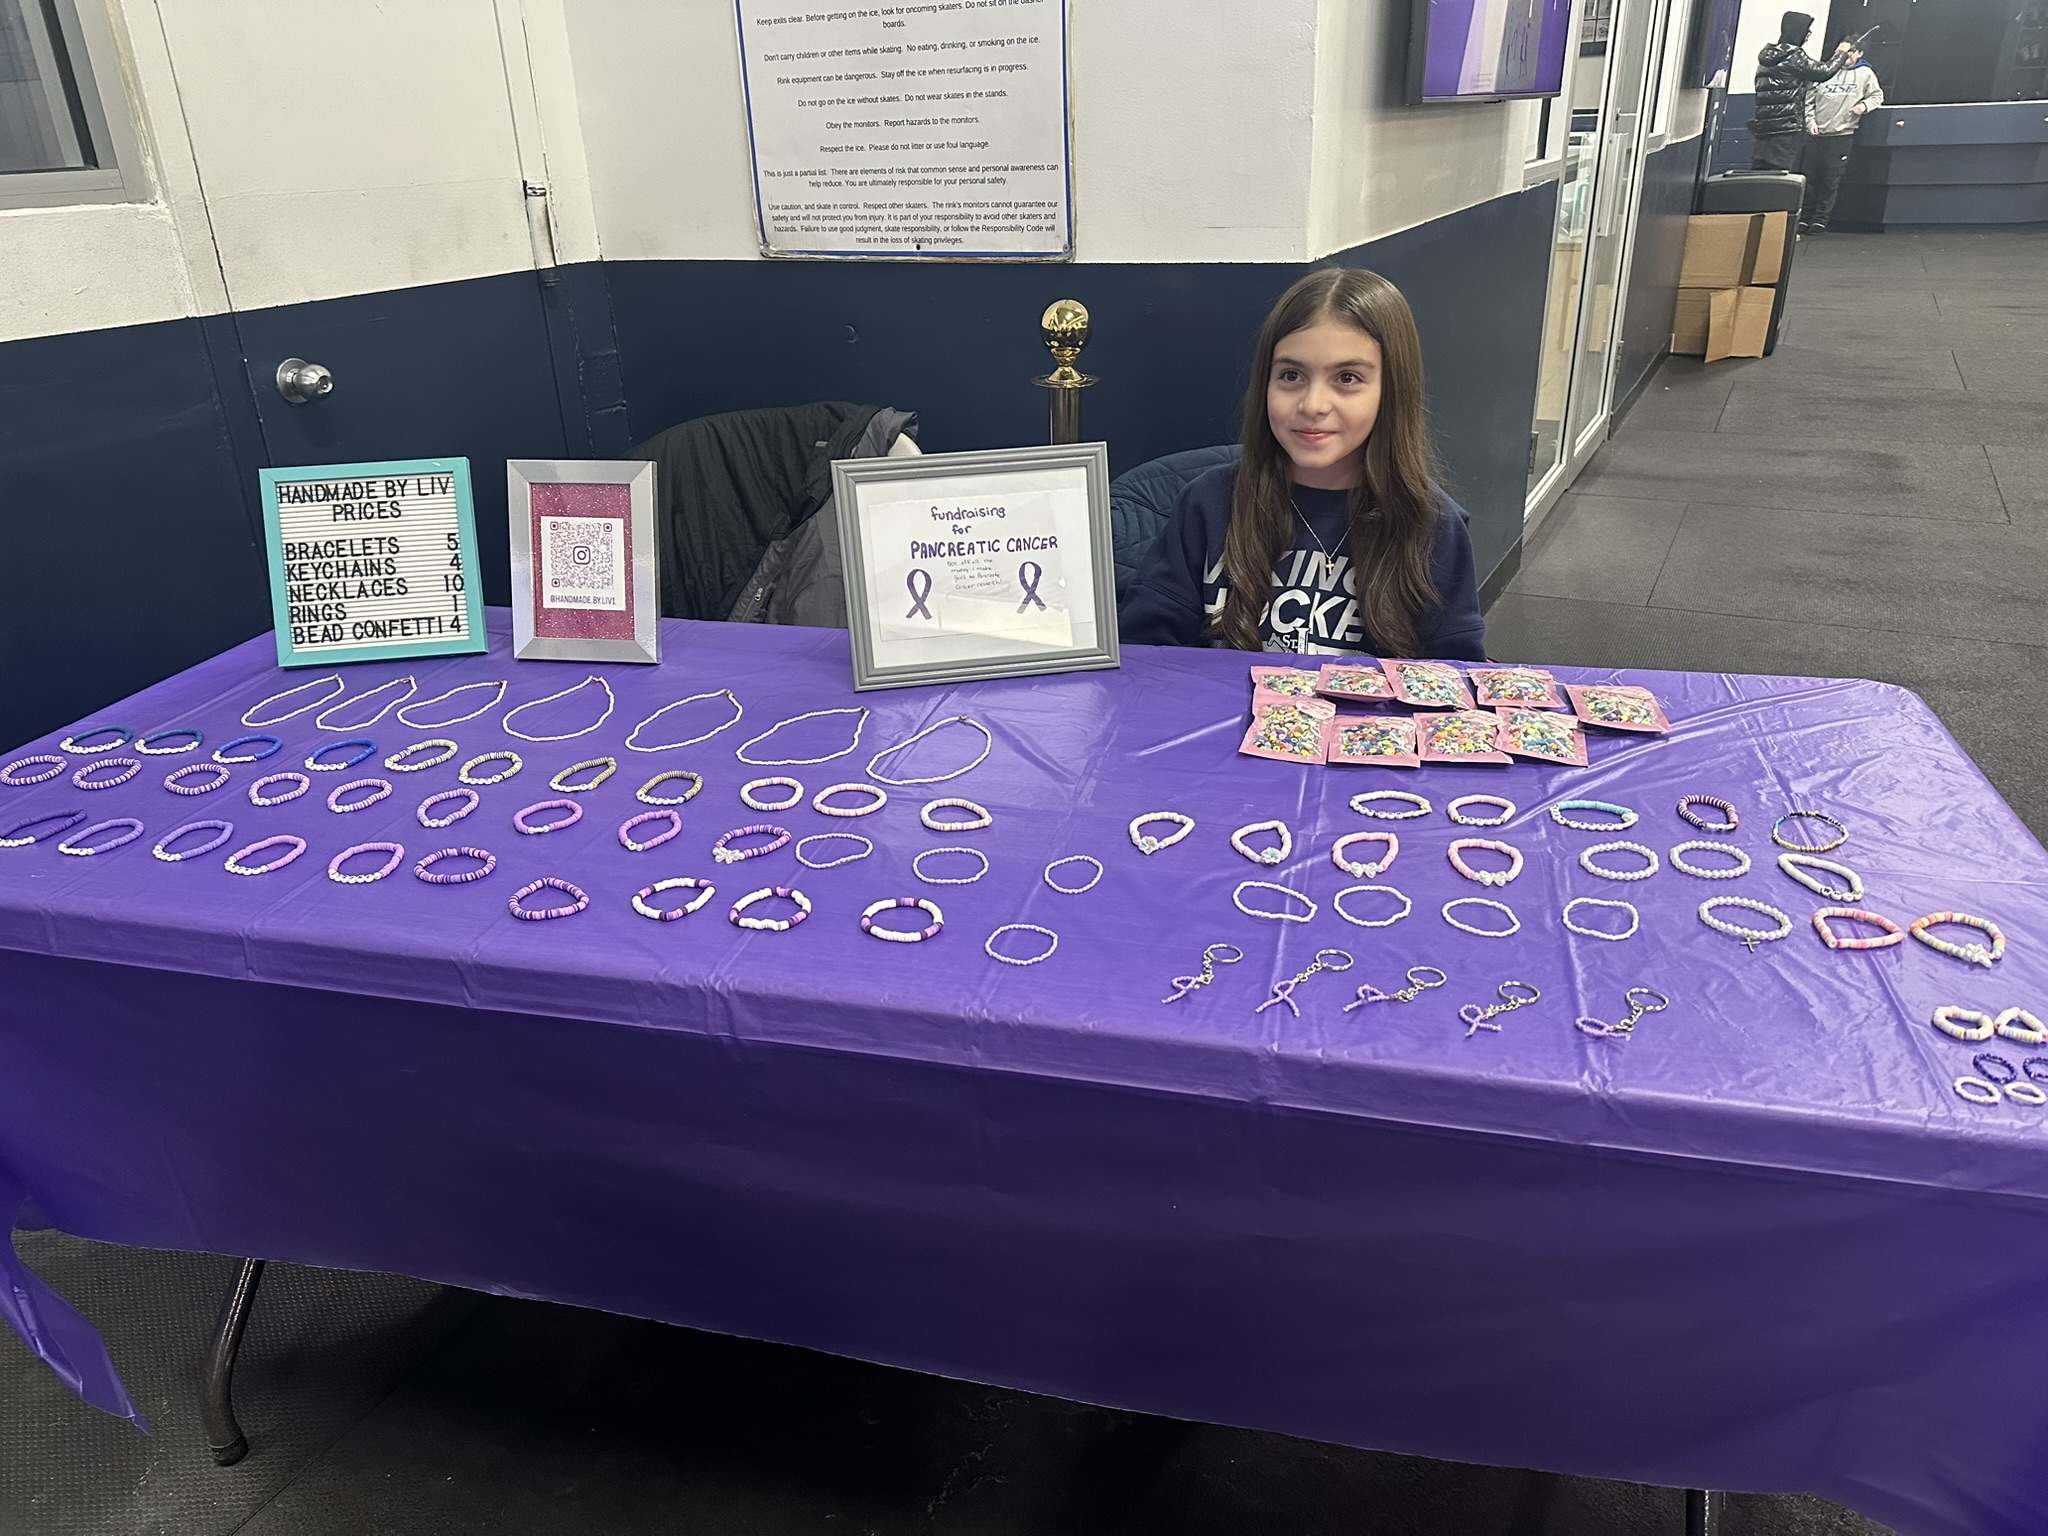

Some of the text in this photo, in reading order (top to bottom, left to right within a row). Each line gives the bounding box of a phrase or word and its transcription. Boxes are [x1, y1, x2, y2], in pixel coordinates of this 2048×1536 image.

[756, 18, 772, 27] Keep
[805, 13, 825, 21] Before
[826, 12, 847, 21] getting
[857, 9, 867, 17] the
[868, 9, 880, 17] ice,
[880, 7, 894, 15] look
[905, 5, 937, 15] oncoming
[938, 2, 962, 10] skaters.
[965, 0, 975, 9] Do
[976, 0, 987, 8] not
[882, 19, 906, 28] boards.
[763, 53, 779, 61] Don't
[780, 53, 795, 62] carry
[795, 51, 819, 59] children
[827, 49, 843, 57] other
[844, 48, 861, 56] items
[861, 46, 878, 55] while
[917, 43, 939, 52] eating,
[940, 40, 967, 51] drinking,
[977, 38, 1005, 48] smoking
[1016, 36, 1027, 44] the
[776, 76, 790, 84] Rink
[791, 75, 822, 84] equipment
[843, 72, 877, 82] dangerous.
[880, 70, 895, 80] Stay
[905, 69, 916, 77] the
[946, 65, 982, 76] resurfacing
[997, 63, 1028, 73] progress.
[856, 96, 878, 104] without
[943, 91, 964, 99] skates
[972, 90, 983, 98] the
[984, 89, 1008, 97] stands.
[825, 121, 841, 130] Obey
[853, 120, 880, 128] monitors.
[883, 119, 905, 128] Report
[951, 116, 980, 124] monitors.
[819, 145, 844, 153] Respect
[868, 143, 889, 151] Please
[782, 170, 793, 178] just
[859, 167, 887, 175] elements
[981, 164, 1009, 173] personal
[808, 180, 821, 188] help
[868, 178, 896, 187] ultimately
[897, 178, 932, 187] responsible
[943, 178, 957, 186] your
[958, 177, 985, 185] personal
[986, 176, 1007, 185] safety.
[862, 201, 887, 210] Respect
[1013, 201, 1046, 209] guarantee
[771, 214, 788, 222] safety
[821, 214, 841, 222] protect
[854, 213, 867, 221] from
[899, 214, 911, 222] part
[919, 214, 933, 222] your
[934, 213, 974, 221] responsibility
[982, 212, 1000, 220] avoid
[839, 225, 853, 233] good
[950, 224, 969, 232] follow
[981, 224, 1024, 233] Responsibility
[911, 237, 932, 245] skating
[933, 236, 962, 245] privileges.
[278, 476, 450, 504] HANDMADE BY LIV
[332, 501, 401, 522] PRICES
[930, 505, 1006, 521] fundraising
[952, 524, 972, 535] for
[285, 533, 458, 561] BRACELETS 5
[910, 535, 1058, 560] PANCREATIC CANCER
[286, 553, 461, 582] KEYCHAINS 4
[289, 574, 464, 603] NECKLACES 10
[550, 594, 616, 606] @HANDMADE.BY.LIV1
[290, 594, 458, 623] RINGS 1
[293, 615, 461, 645] BEAD CONFETTI 4
